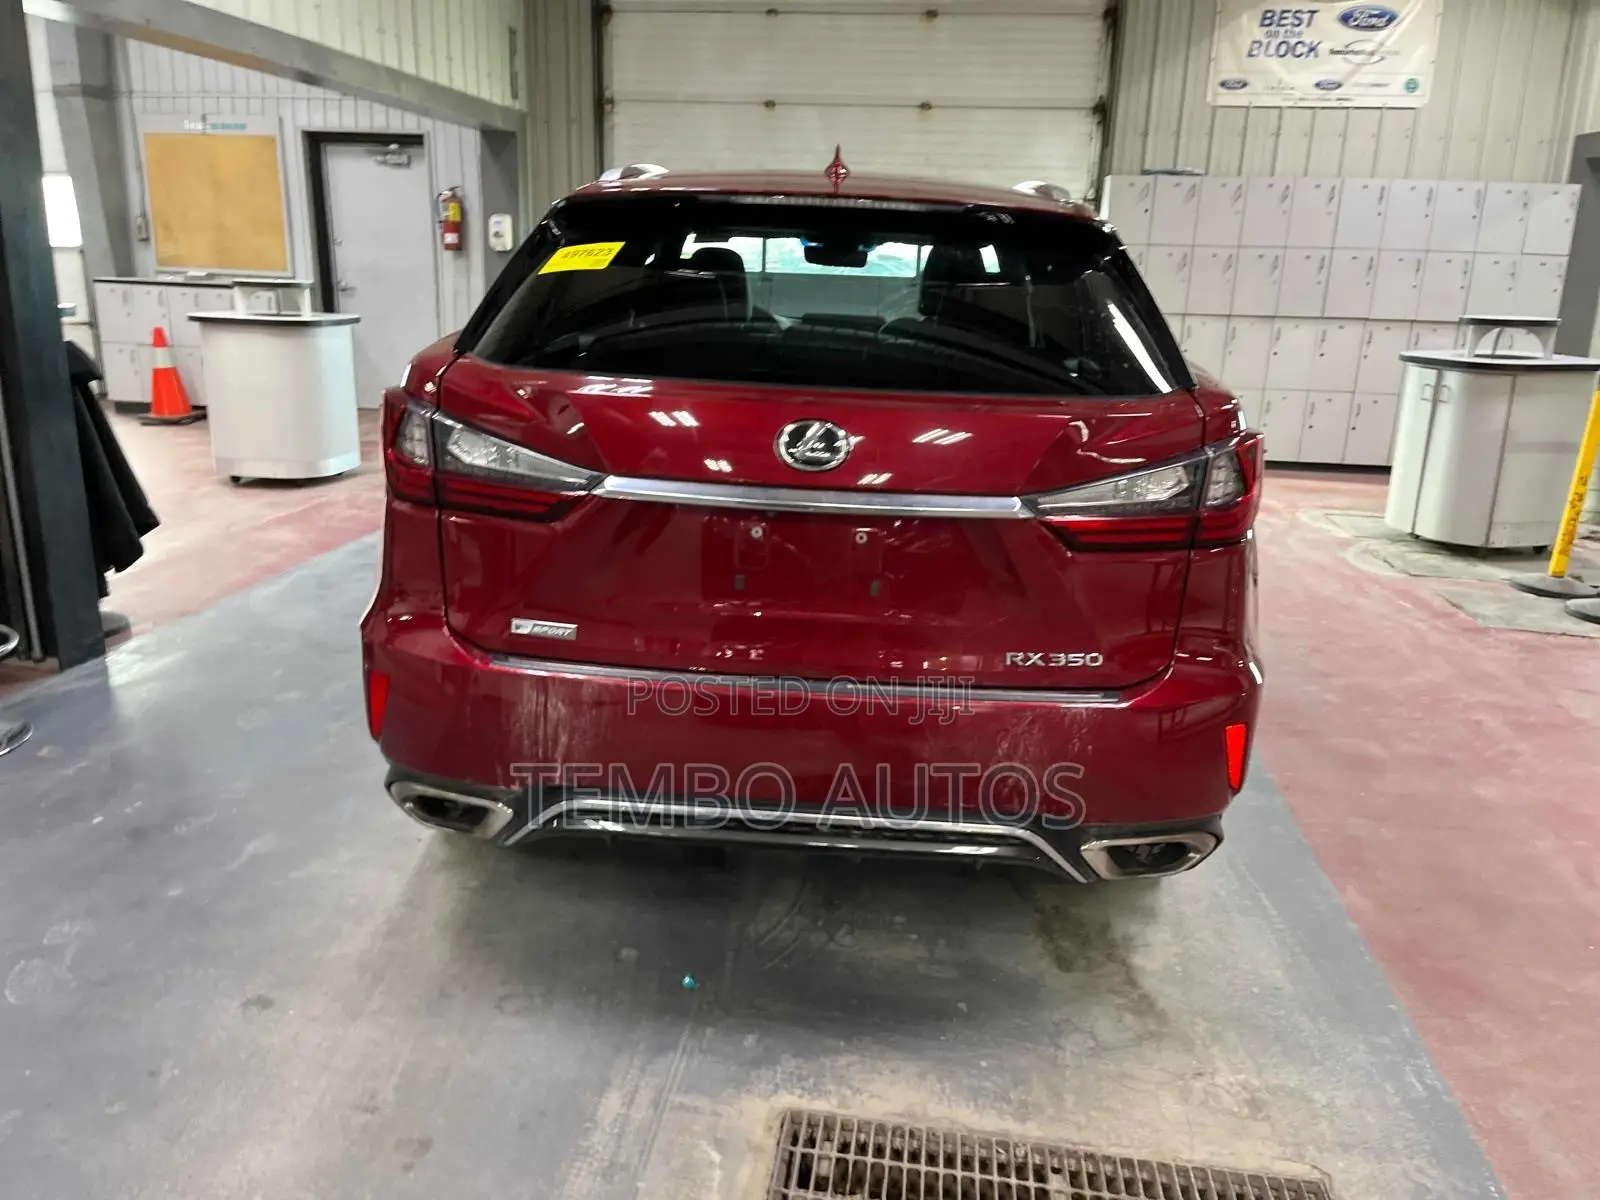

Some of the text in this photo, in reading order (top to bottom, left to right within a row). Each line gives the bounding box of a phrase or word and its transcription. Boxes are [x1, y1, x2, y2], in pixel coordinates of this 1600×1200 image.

[1259, 9, 1320, 28] BEST
[1283, 28, 1304, 39] the
[1247, 40, 1322, 58] BLOCK
[532, 625, 573, 636] SPORT
[1006, 652, 1103, 666] RX 350
